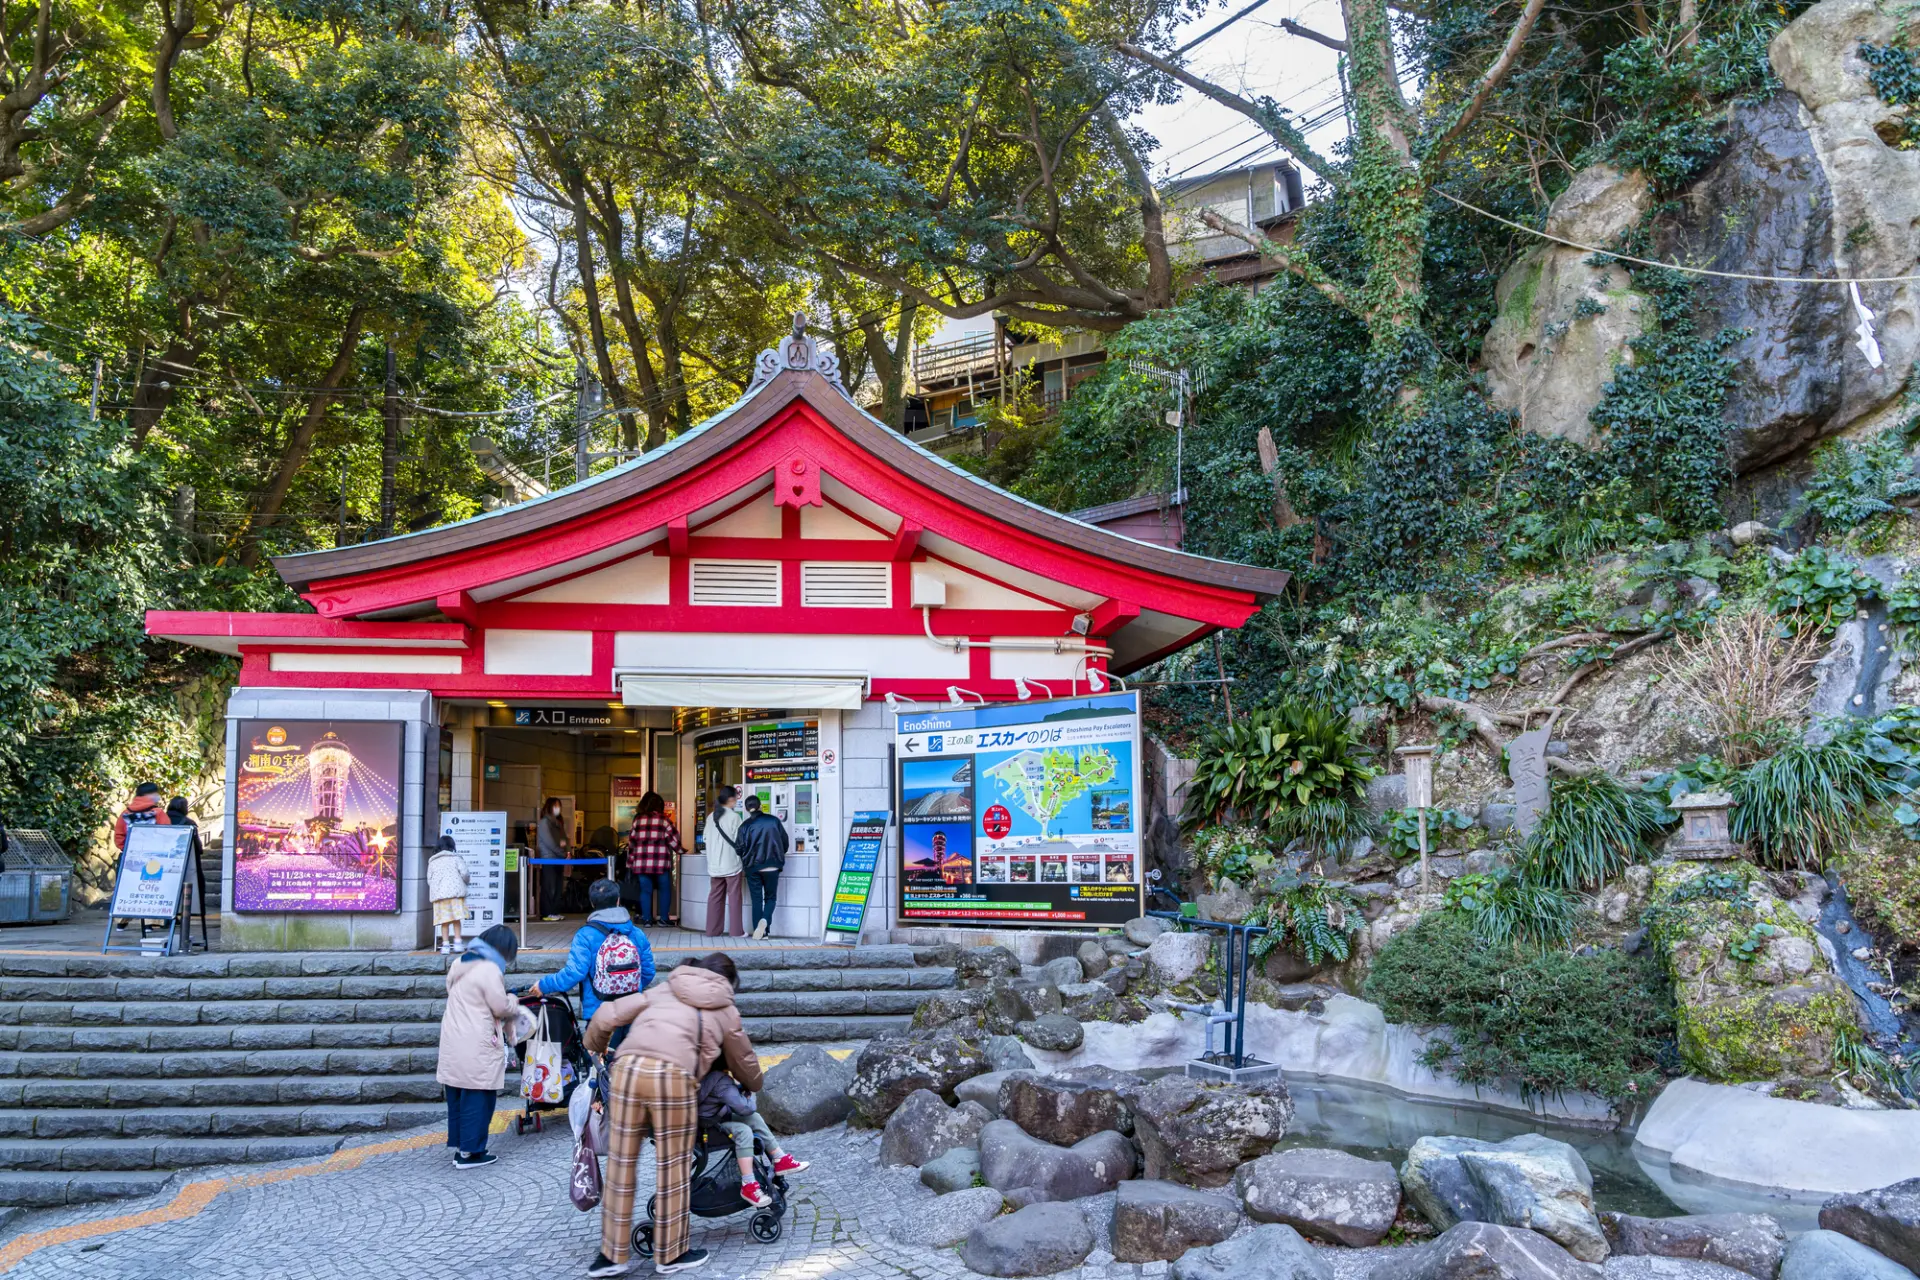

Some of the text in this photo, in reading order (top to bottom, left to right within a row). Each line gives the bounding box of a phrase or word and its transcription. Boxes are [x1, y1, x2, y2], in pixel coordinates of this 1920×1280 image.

[535, 710, 611, 724] 入口 Entrance
[903, 718, 952, 731] EnoShima
[1066, 726, 1092, 734] Enoshima
[947, 734, 974, 746] 江の島
[249, 753, 305, 768] 湘南の宝石
[138, 883, 160, 892] Cafe
[130, 892, 165, 900] 日本で初めての
[119, 899, 173, 907] フレンチトースト専門店
